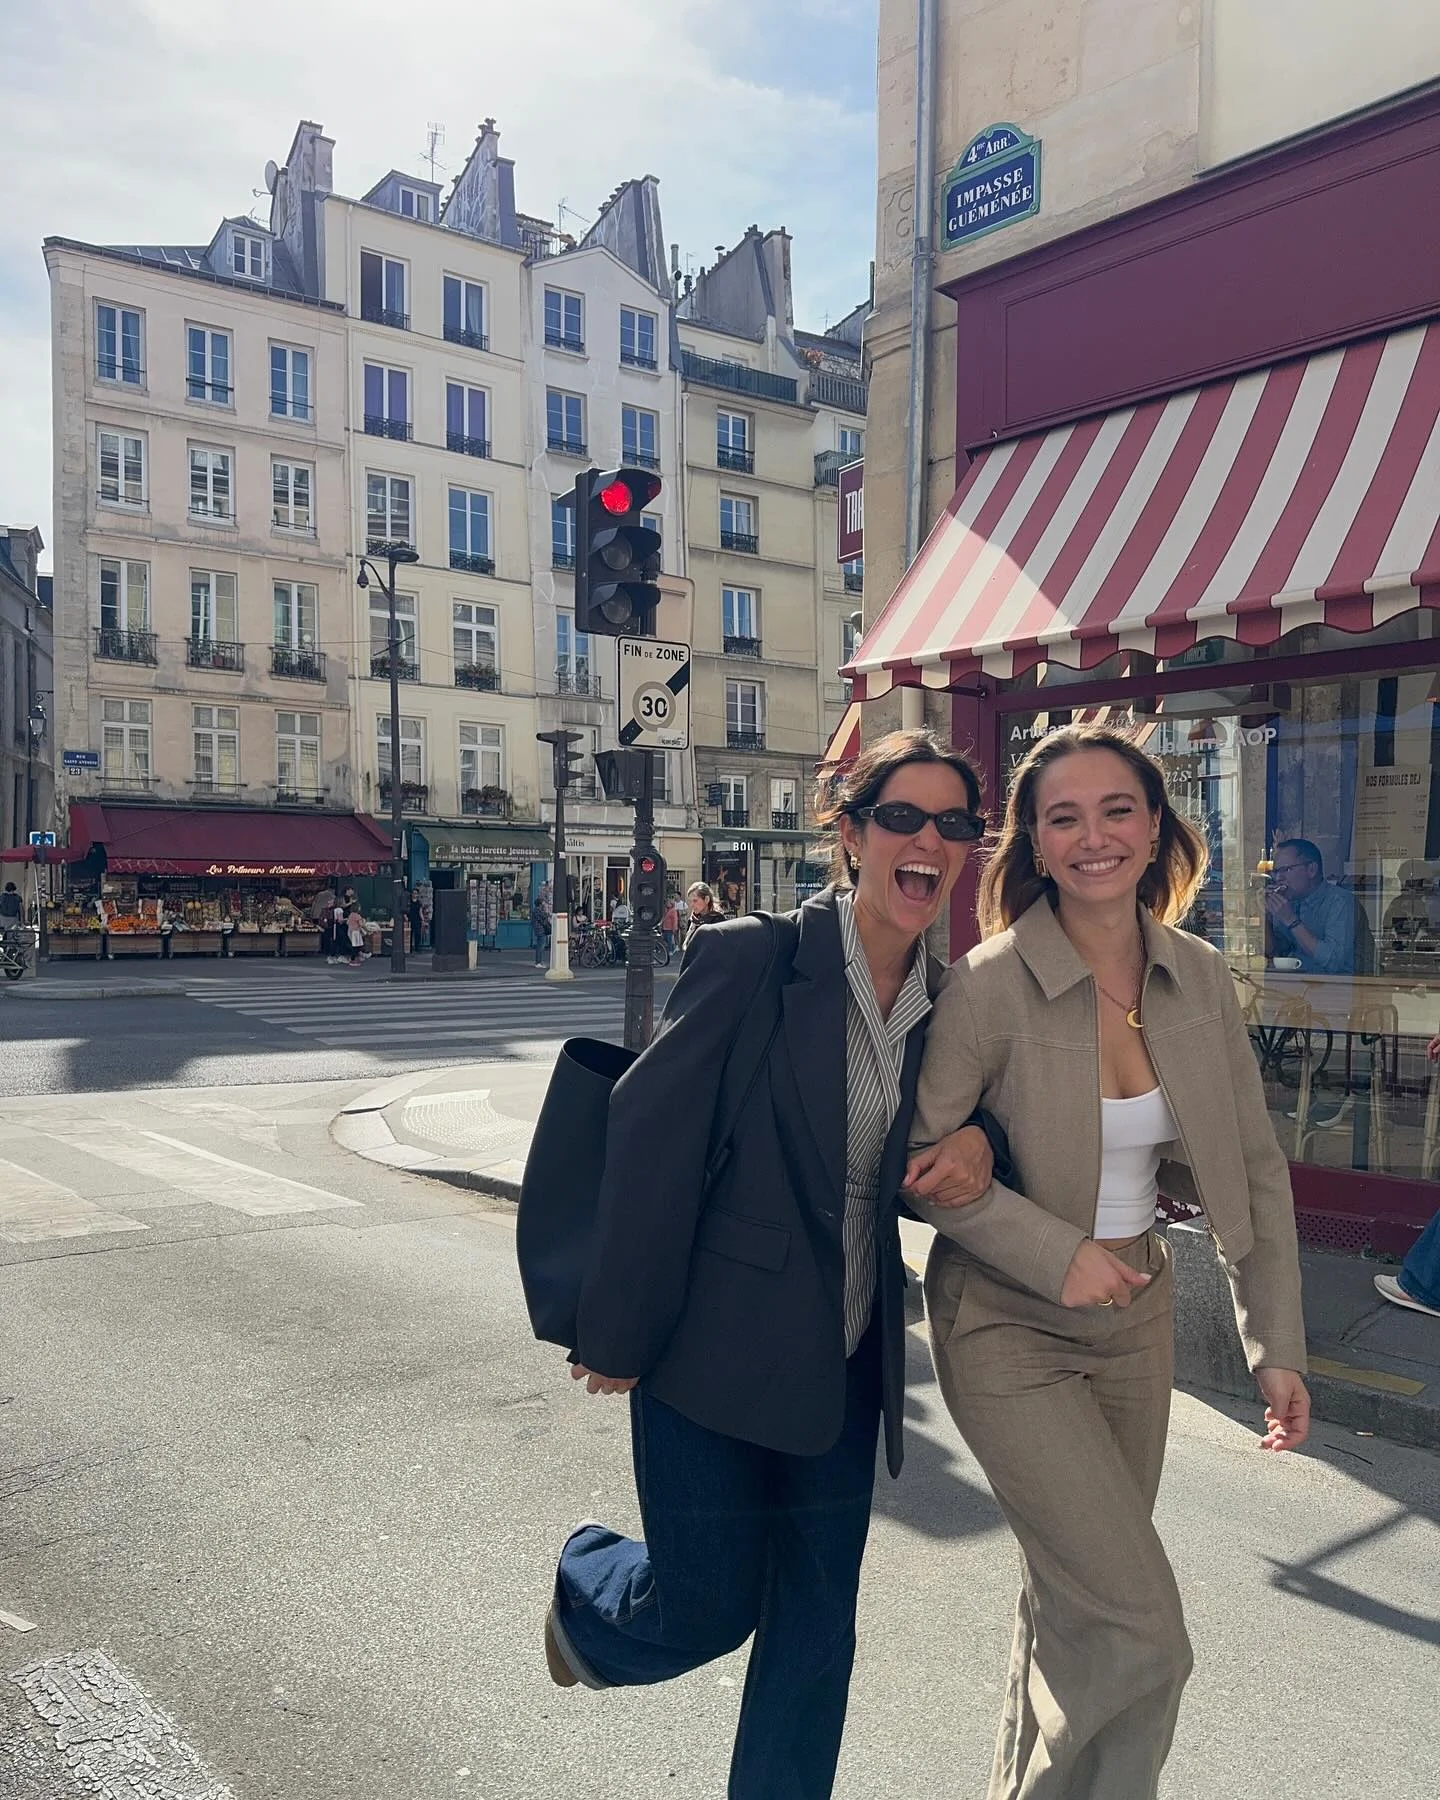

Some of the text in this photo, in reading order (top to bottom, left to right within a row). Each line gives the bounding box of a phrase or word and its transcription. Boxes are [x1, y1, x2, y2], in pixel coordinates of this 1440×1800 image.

[956, 167, 1024, 208] IMPASSE
[948, 183, 1032, 232] GUÉMÉNÉE
[623, 644, 685, 662] FIN DE ZONE
[641, 695, 668, 718] 30
[1235, 726, 1277, 747] AOP
[460, 845, 479, 854] belle
[509, 846, 540, 855] jeunesse
[206, 864, 316, 875] Les Primeurs d'Excellence
